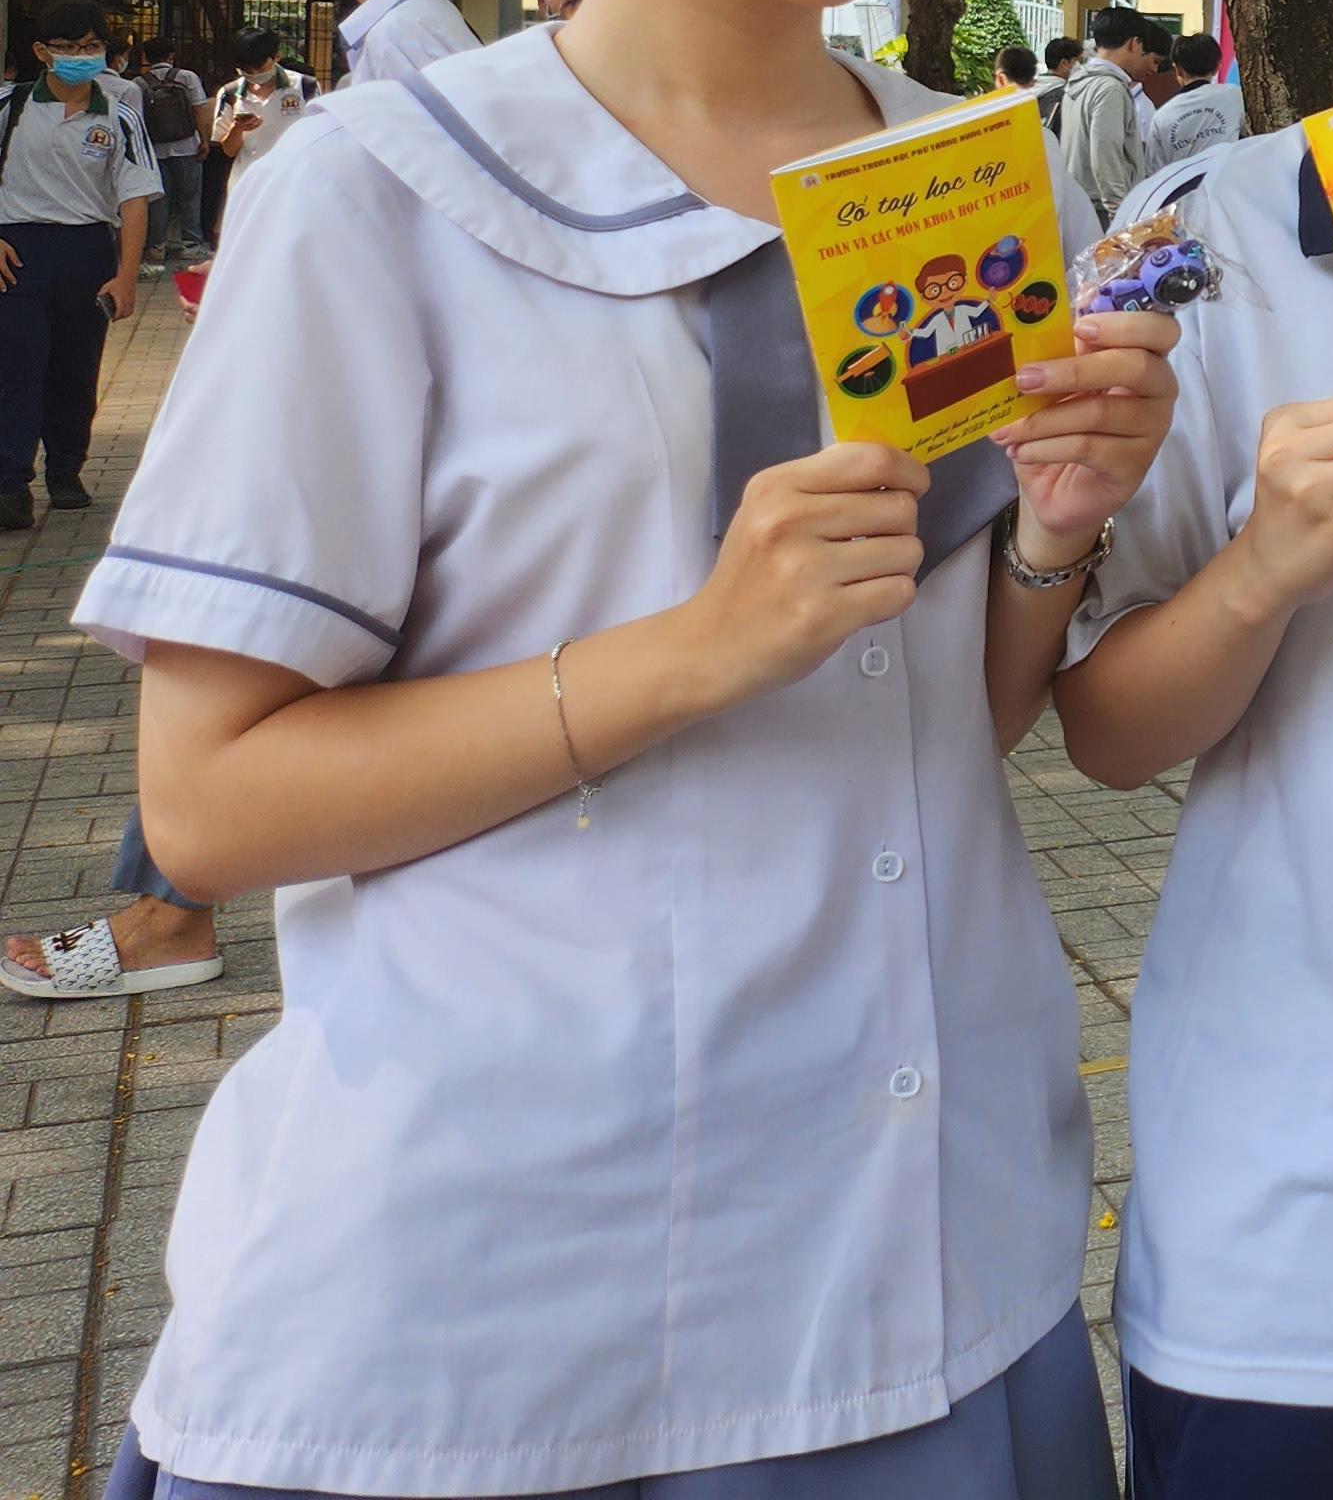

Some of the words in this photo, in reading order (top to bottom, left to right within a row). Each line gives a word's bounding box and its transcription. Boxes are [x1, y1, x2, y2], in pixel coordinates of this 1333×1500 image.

[878, 191, 918, 217] tay
[925, 175, 966, 199] học
[974, 160, 1006, 187] tập
[924, 210, 956, 230] KHOA
